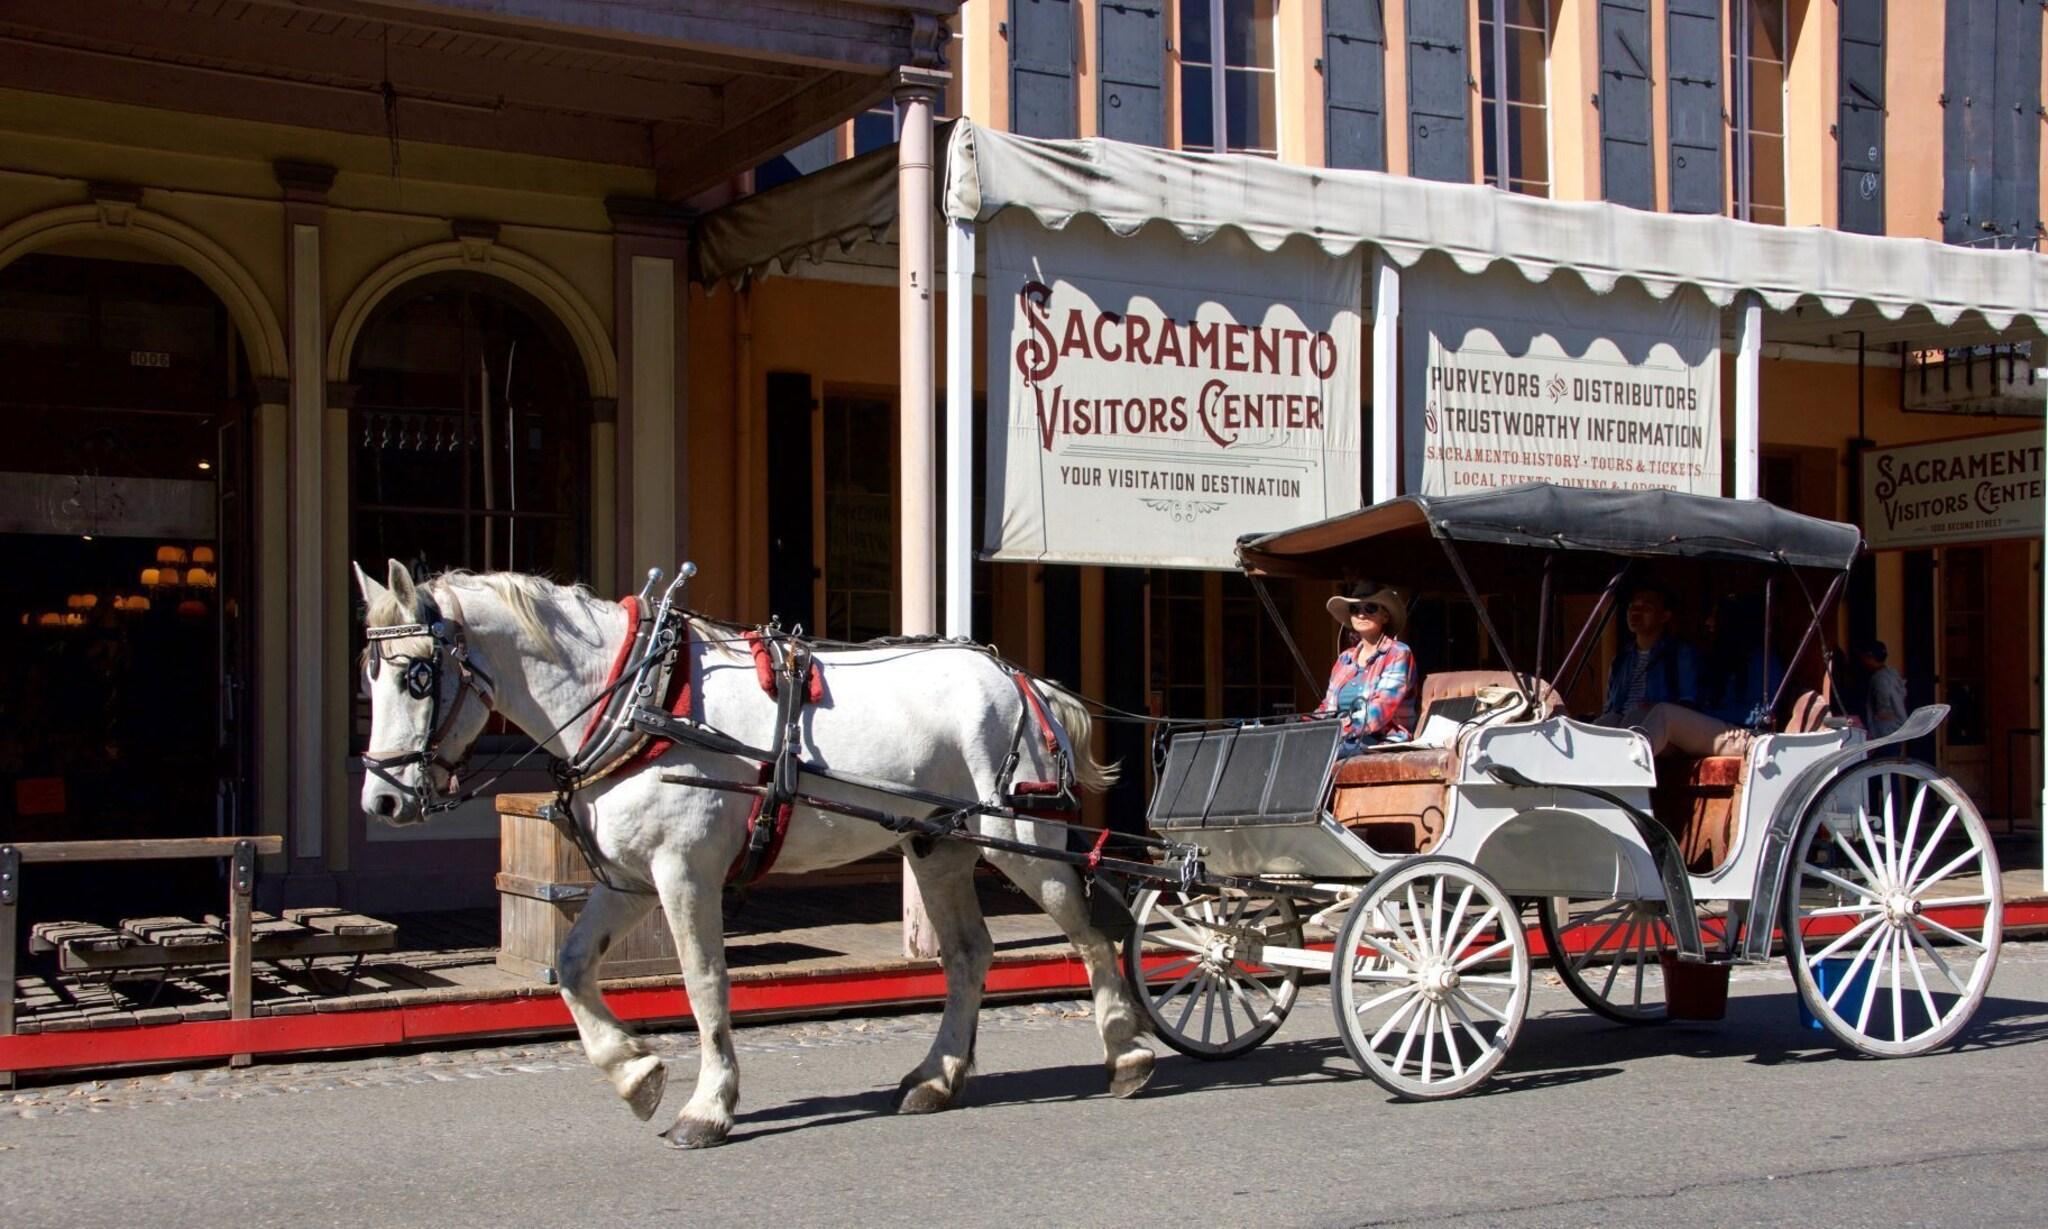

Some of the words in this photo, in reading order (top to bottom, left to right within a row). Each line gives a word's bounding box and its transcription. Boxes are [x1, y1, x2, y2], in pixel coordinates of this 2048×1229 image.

[1016, 281, 1337, 387] SACRAMENTO
[1431, 366, 1540, 398] PURVEYORS
[1573, 378, 1697, 411] DISTRIBUTORS
[1032, 383, 1188, 452] VISITORS
[1197, 379, 1324, 448] CENTER
[1444, 407, 1581, 441] TRUSTWORTHY
[1587, 418, 1703, 449] INFORMATION
[1060, 466, 1101, 486] YOUR
[1108, 468, 1196, 492] VISITATION
[1201, 474, 1301, 498] DESTINATION
[1427, 446, 1519, 465] SACRAMENTO
[1523, 451, 1580, 468] HISTORY
[1590, 456, 1633, 472] TOURS
[1636, 460, 1645, 473] &
[1649, 460, 1702, 477] TICKETS
[1454, 471, 1497, 487] LOCAL
[1875, 447, 2044, 503] SACRAMENT
[1882, 493, 1968, 531] VISITORS
[1974, 478, 2046, 514] CENTE
